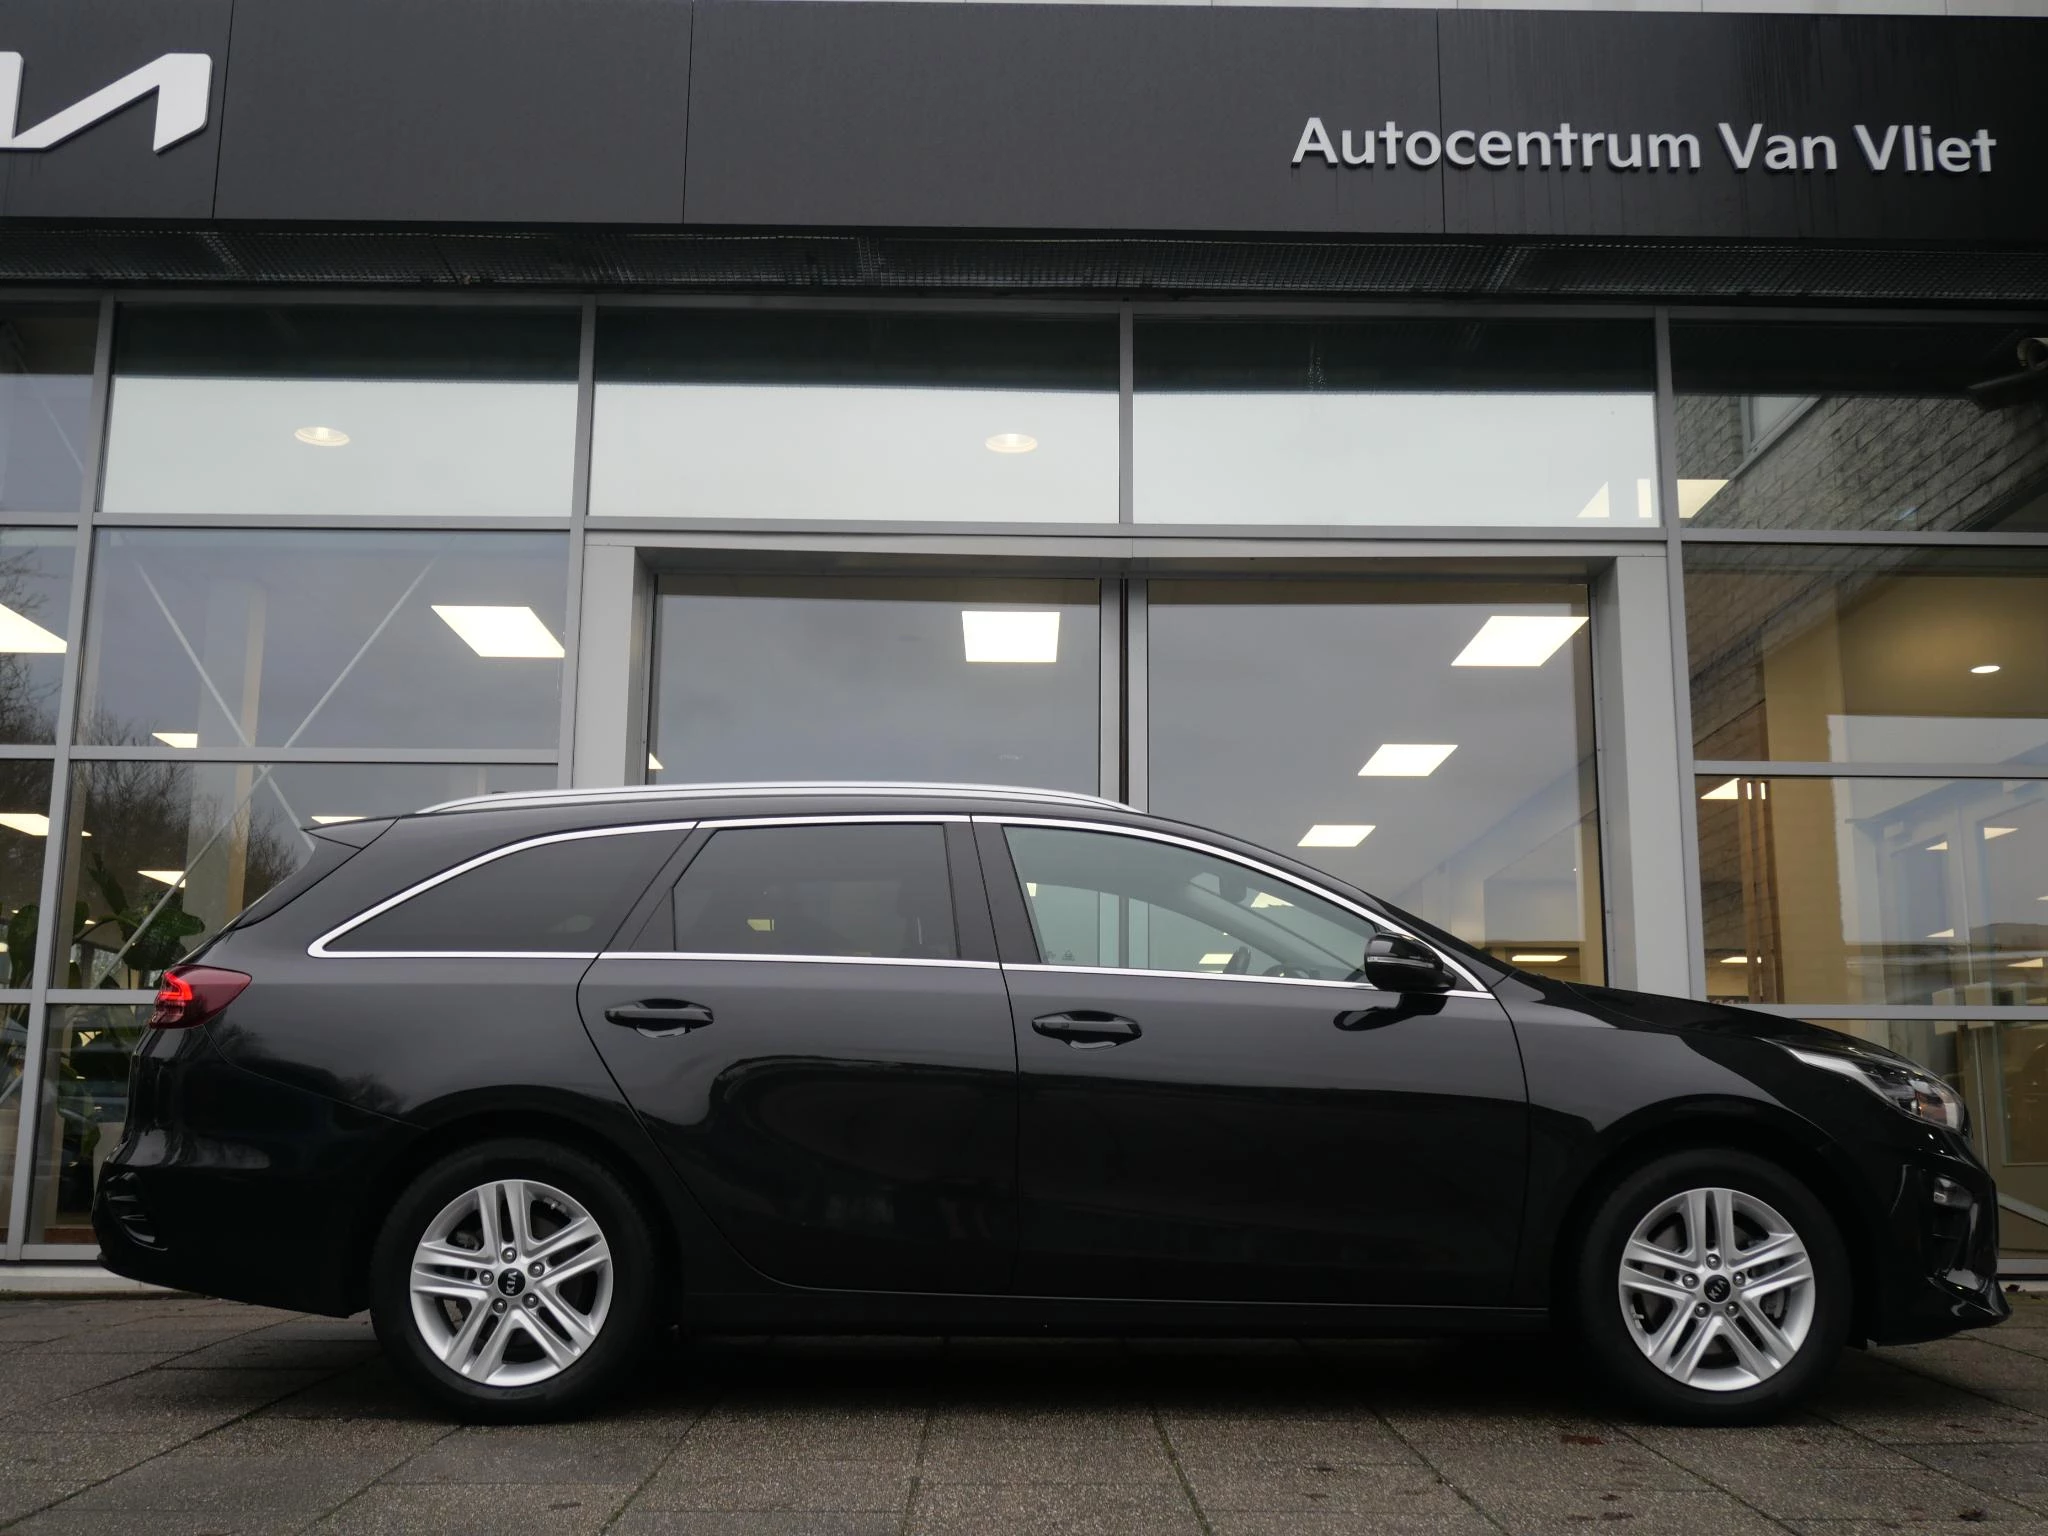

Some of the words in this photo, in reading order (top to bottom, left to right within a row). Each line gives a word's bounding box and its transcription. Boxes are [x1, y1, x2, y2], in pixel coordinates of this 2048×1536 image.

[1291, 116, 1702, 170] Autocentrum
[1716, 122, 1838, 171] Van
[1852, 124, 1998, 173] Vliet
